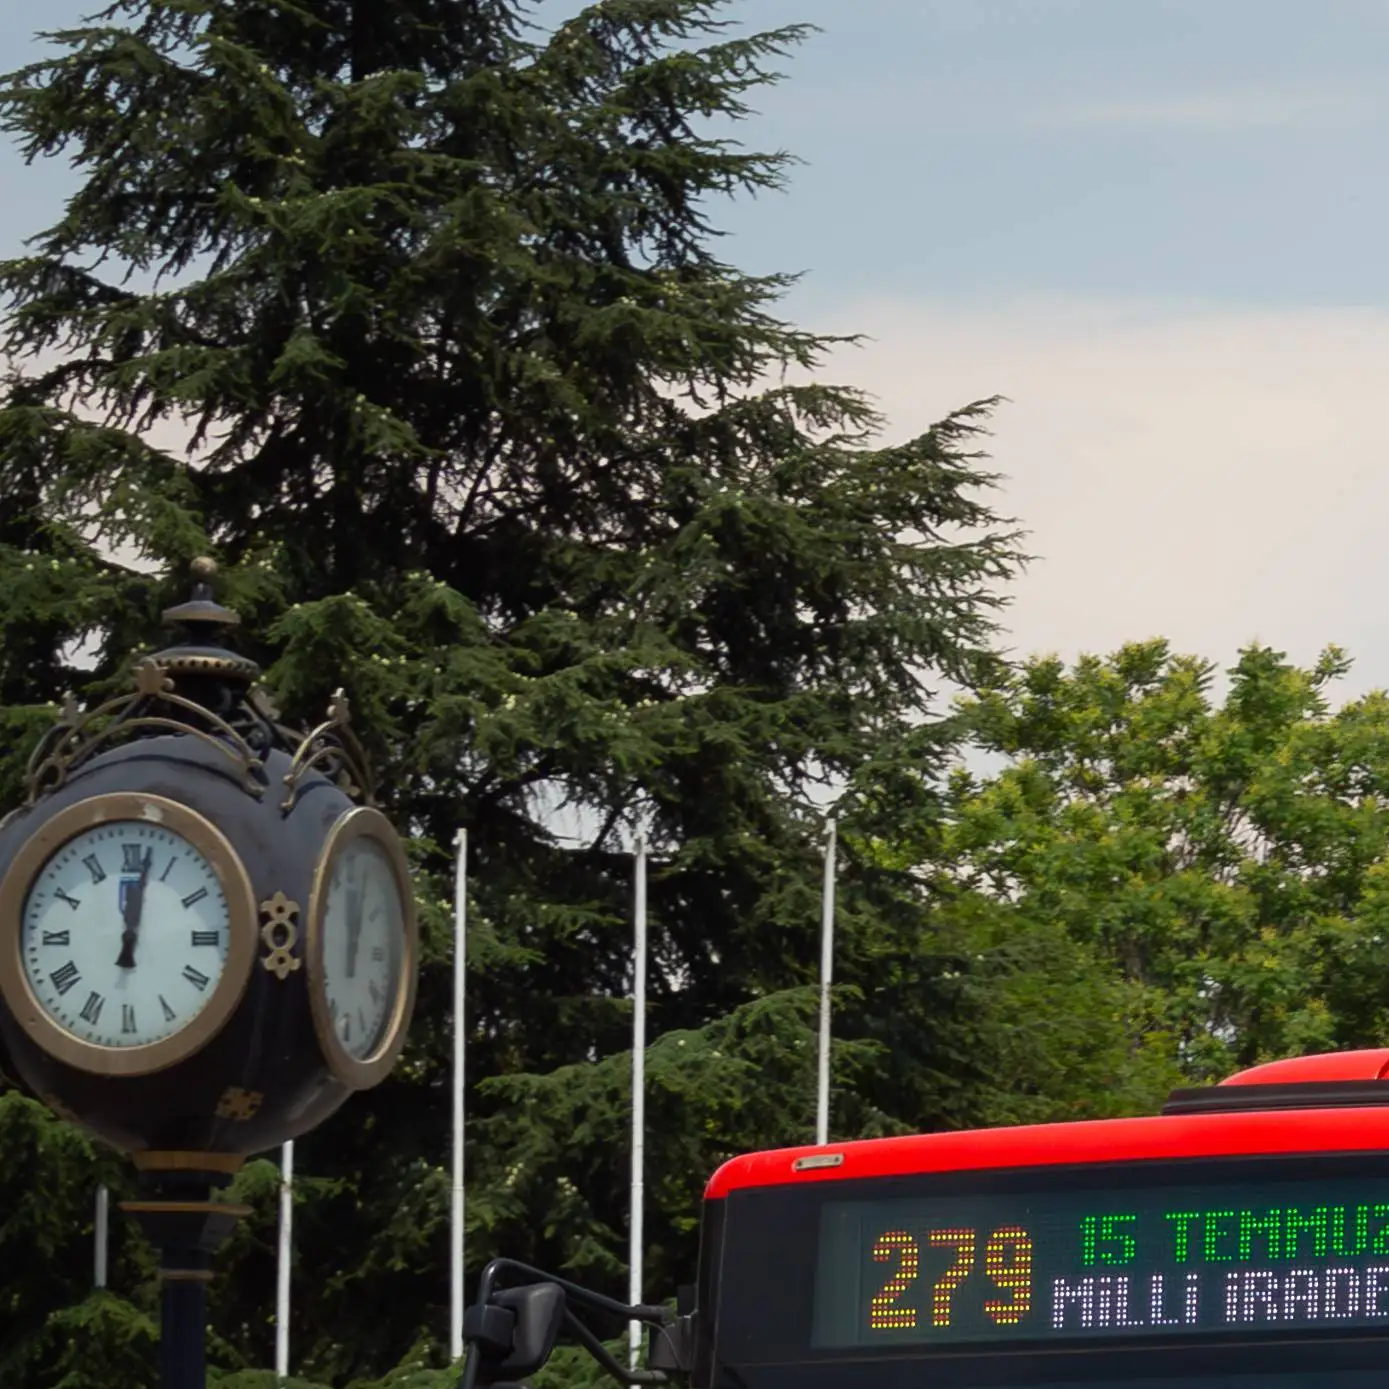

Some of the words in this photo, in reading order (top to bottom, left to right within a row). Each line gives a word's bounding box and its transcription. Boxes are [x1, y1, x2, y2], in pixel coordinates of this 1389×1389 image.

[159, 856, 178, 881] I
[181, 886, 208, 909] II
[191, 931, 219, 947] III
[1079, 1214, 1136, 1266] 15
[871, 1226, 1032, 1329] 279
